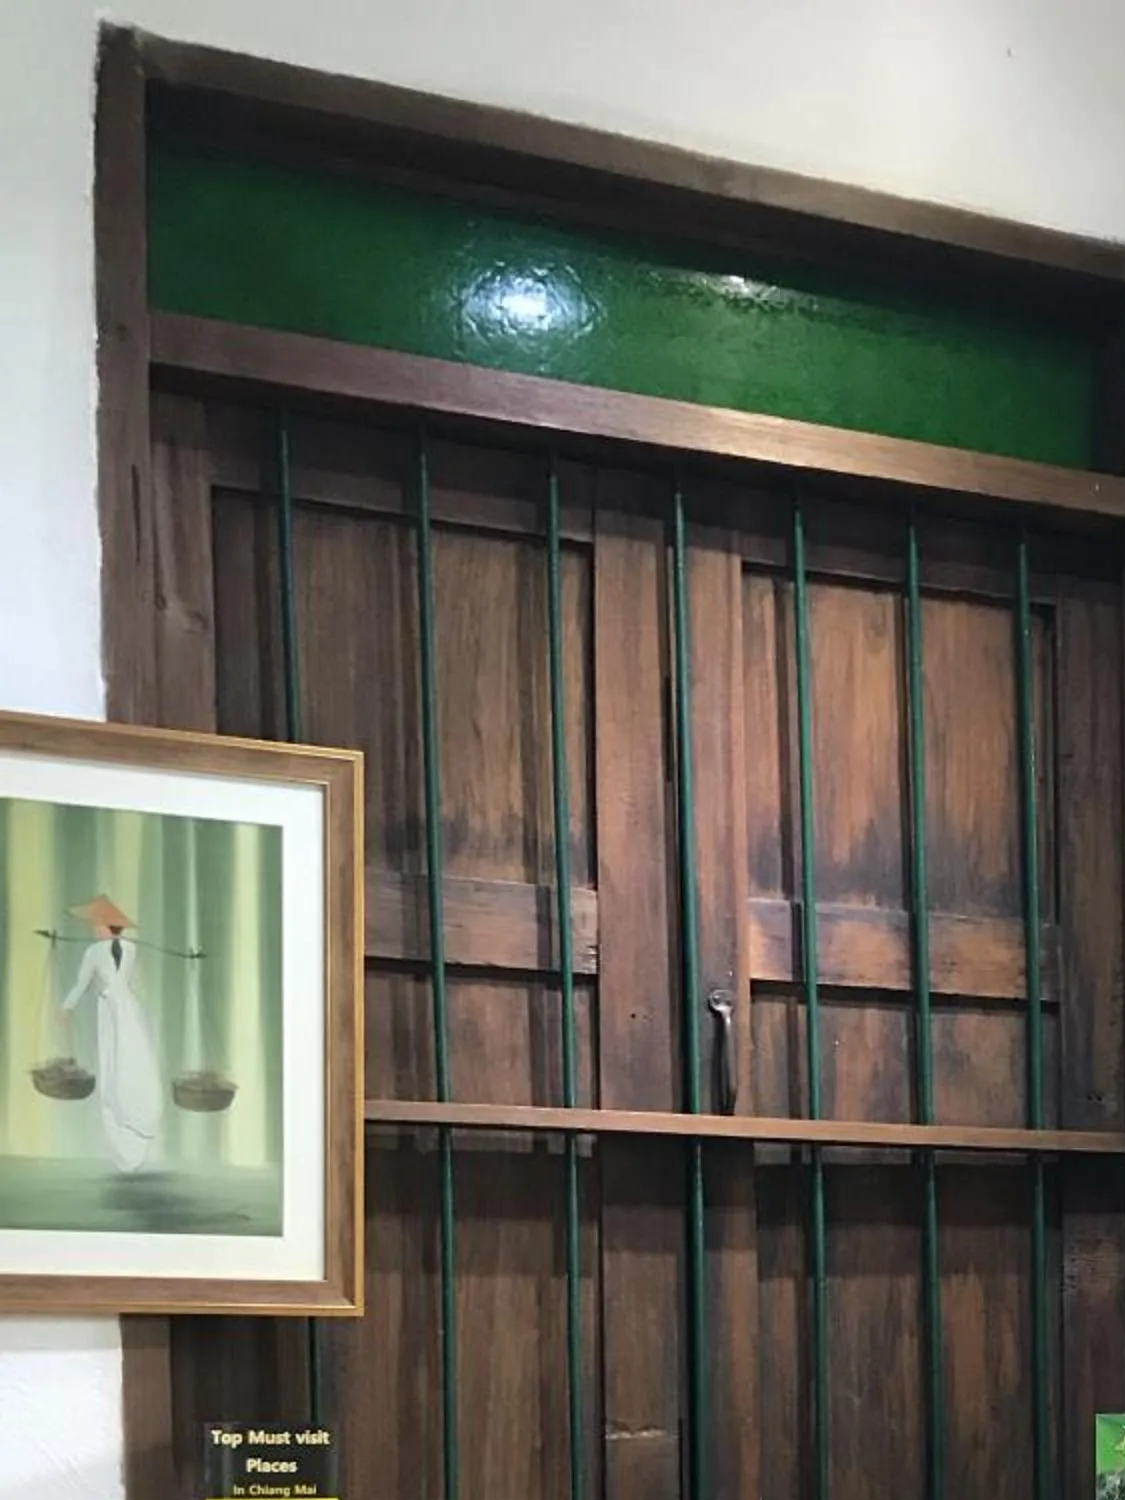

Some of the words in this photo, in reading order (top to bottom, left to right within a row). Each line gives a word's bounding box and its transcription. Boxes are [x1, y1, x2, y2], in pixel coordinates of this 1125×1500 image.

[211, 1429, 243, 1448] Top
[248, 1430, 291, 1445] Must
[295, 1429, 330, 1445] visit
[246, 1458, 298, 1473] Places
[249, 1484, 291, 1498] Chiang
[294, 1484, 317, 1495] Mai
